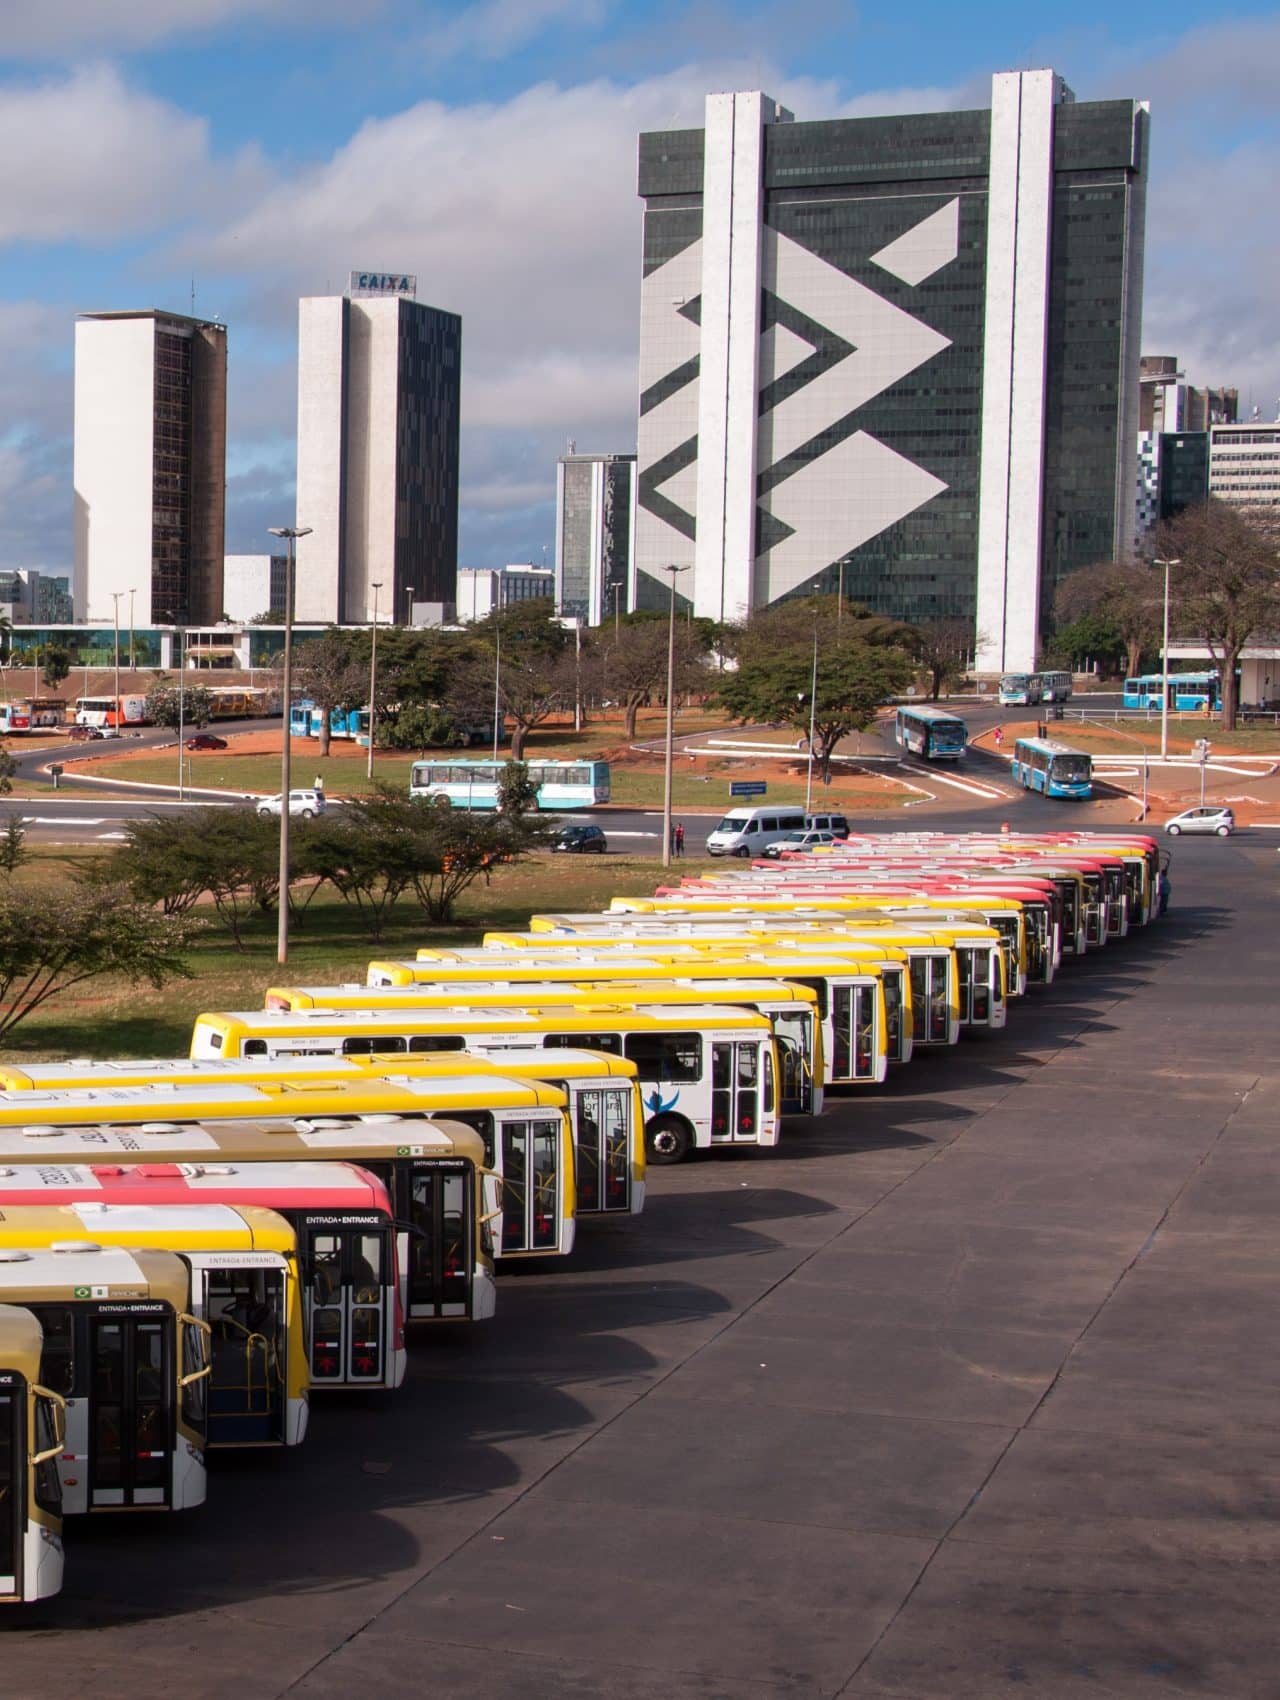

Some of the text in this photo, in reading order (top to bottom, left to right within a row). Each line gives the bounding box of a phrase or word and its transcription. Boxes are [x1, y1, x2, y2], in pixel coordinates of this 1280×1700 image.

[359, 275, 409, 290] CAIXA
[306, 1216, 379, 1224] ENTRADA ENTRANCE
